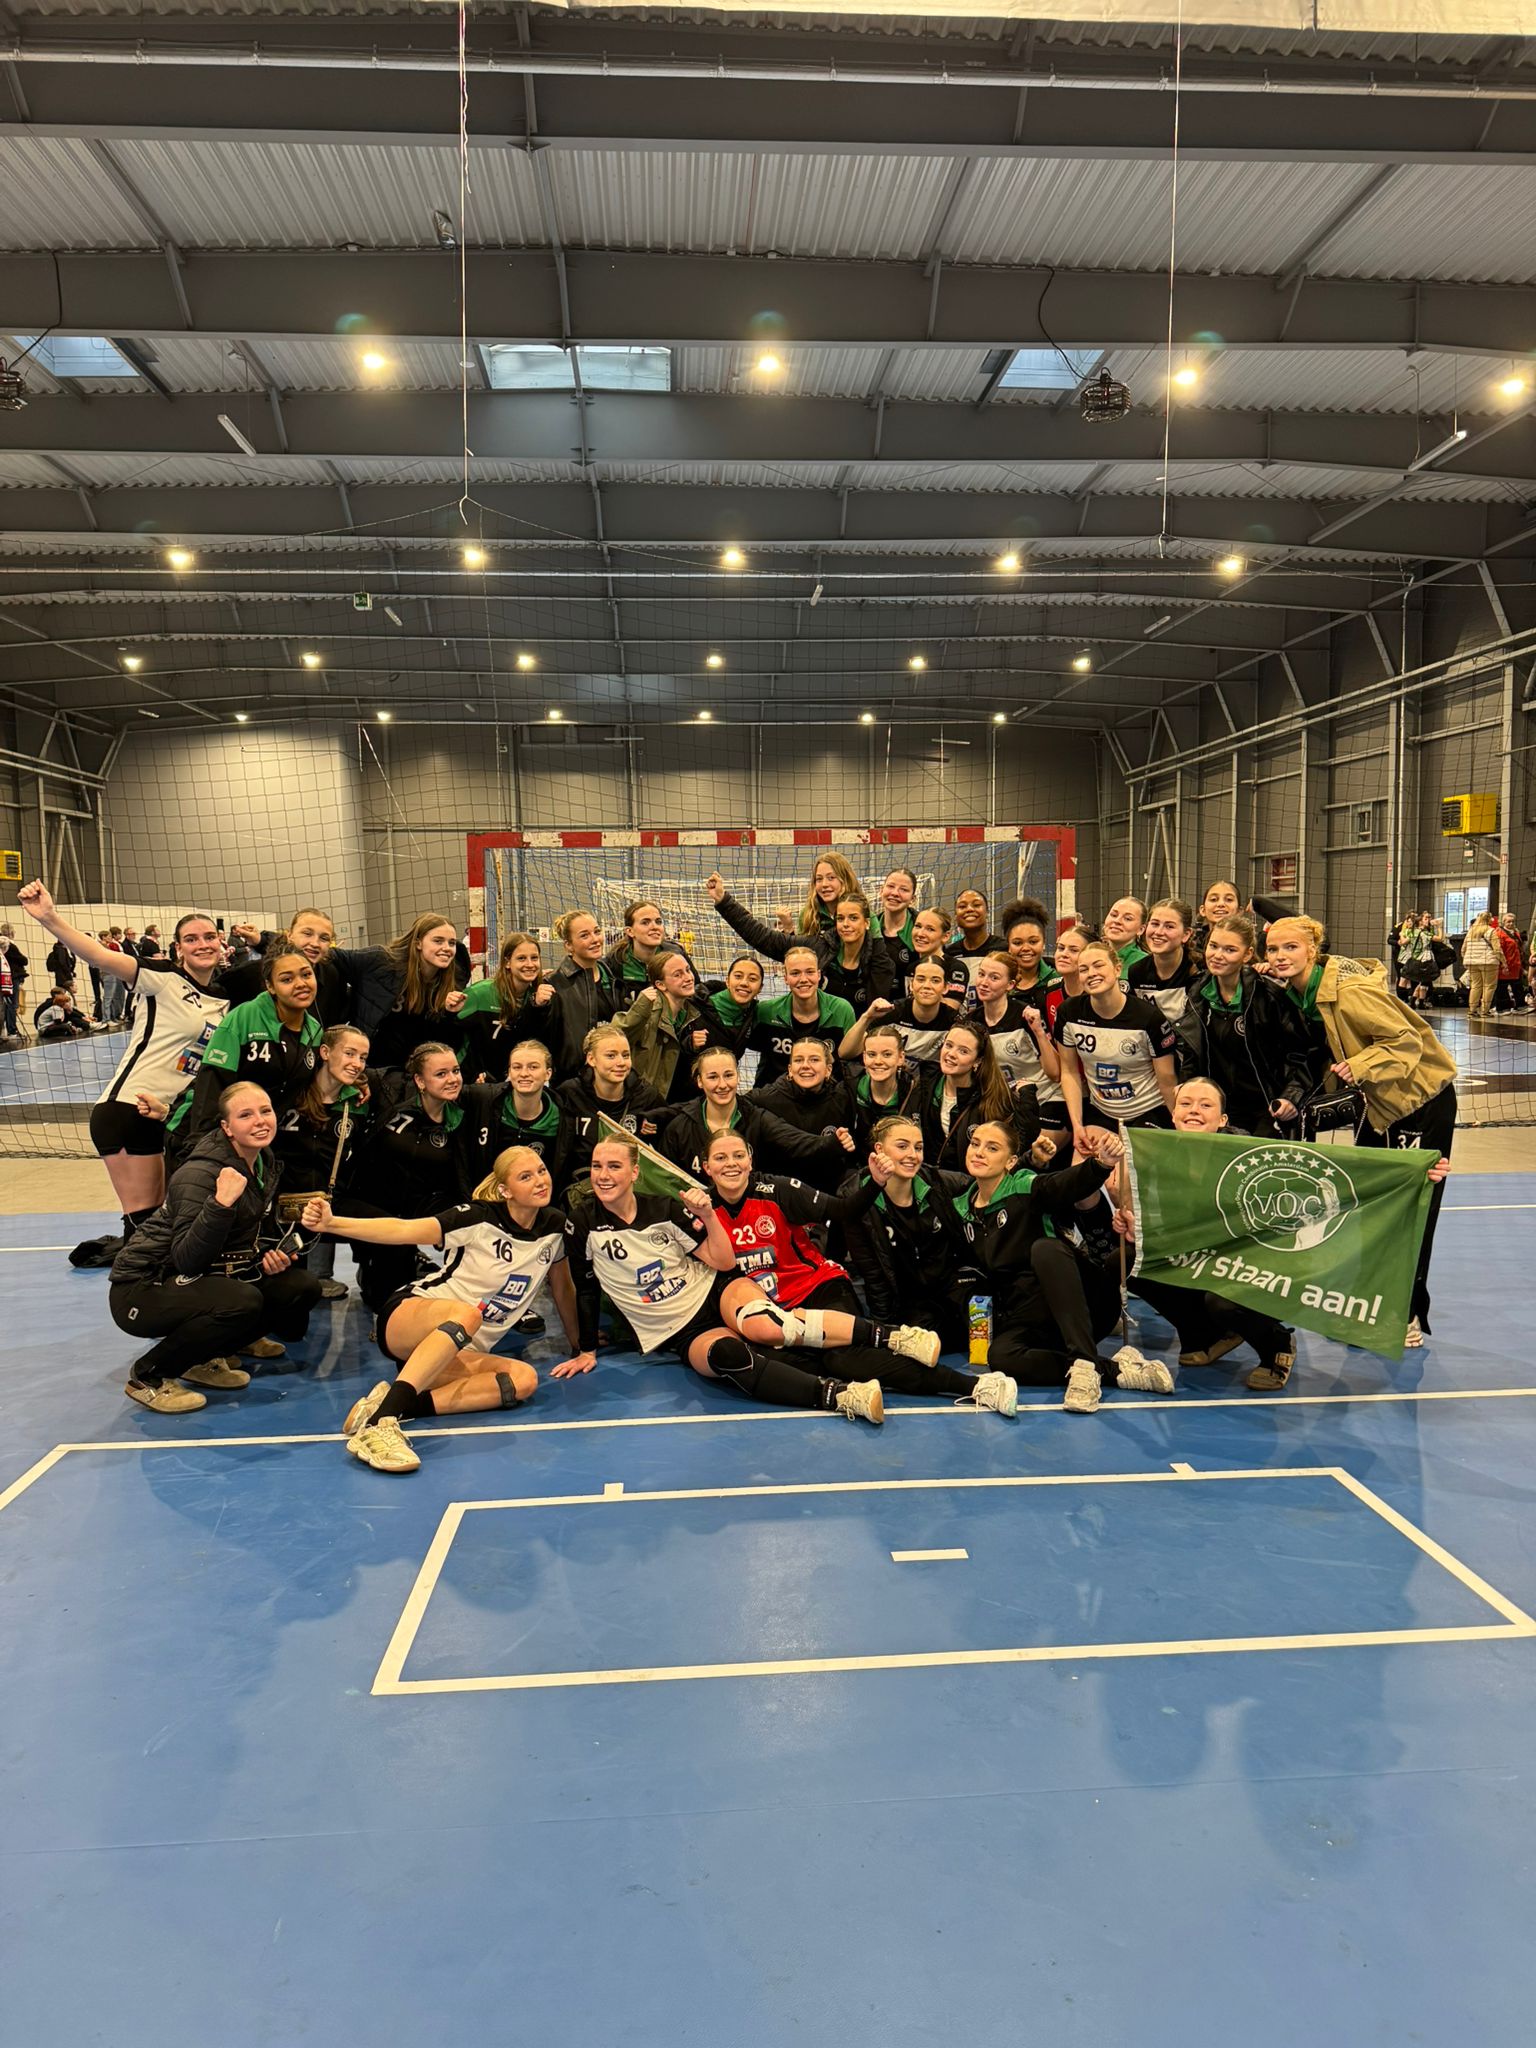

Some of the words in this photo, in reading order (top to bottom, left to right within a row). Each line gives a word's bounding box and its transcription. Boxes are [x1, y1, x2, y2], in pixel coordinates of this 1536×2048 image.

[247, 1041, 271, 1063] 34
[771, 1037, 793, 1055] 26
[1074, 1033, 1097, 1053] 29
[1397, 1134, 1421, 1150] 34
[732, 1225, 757, 1246] 23
[492, 1238, 513, 1263] 16
[601, 1238, 628, 1261] 18
[736, 1251, 774, 1271] TMA
[502, 1281, 528, 1296] BD
[649, 1278, 684, 1301] TMA
[1211, 1256, 1292, 1298] staan
[1300, 1284, 1383, 1325] aan!
